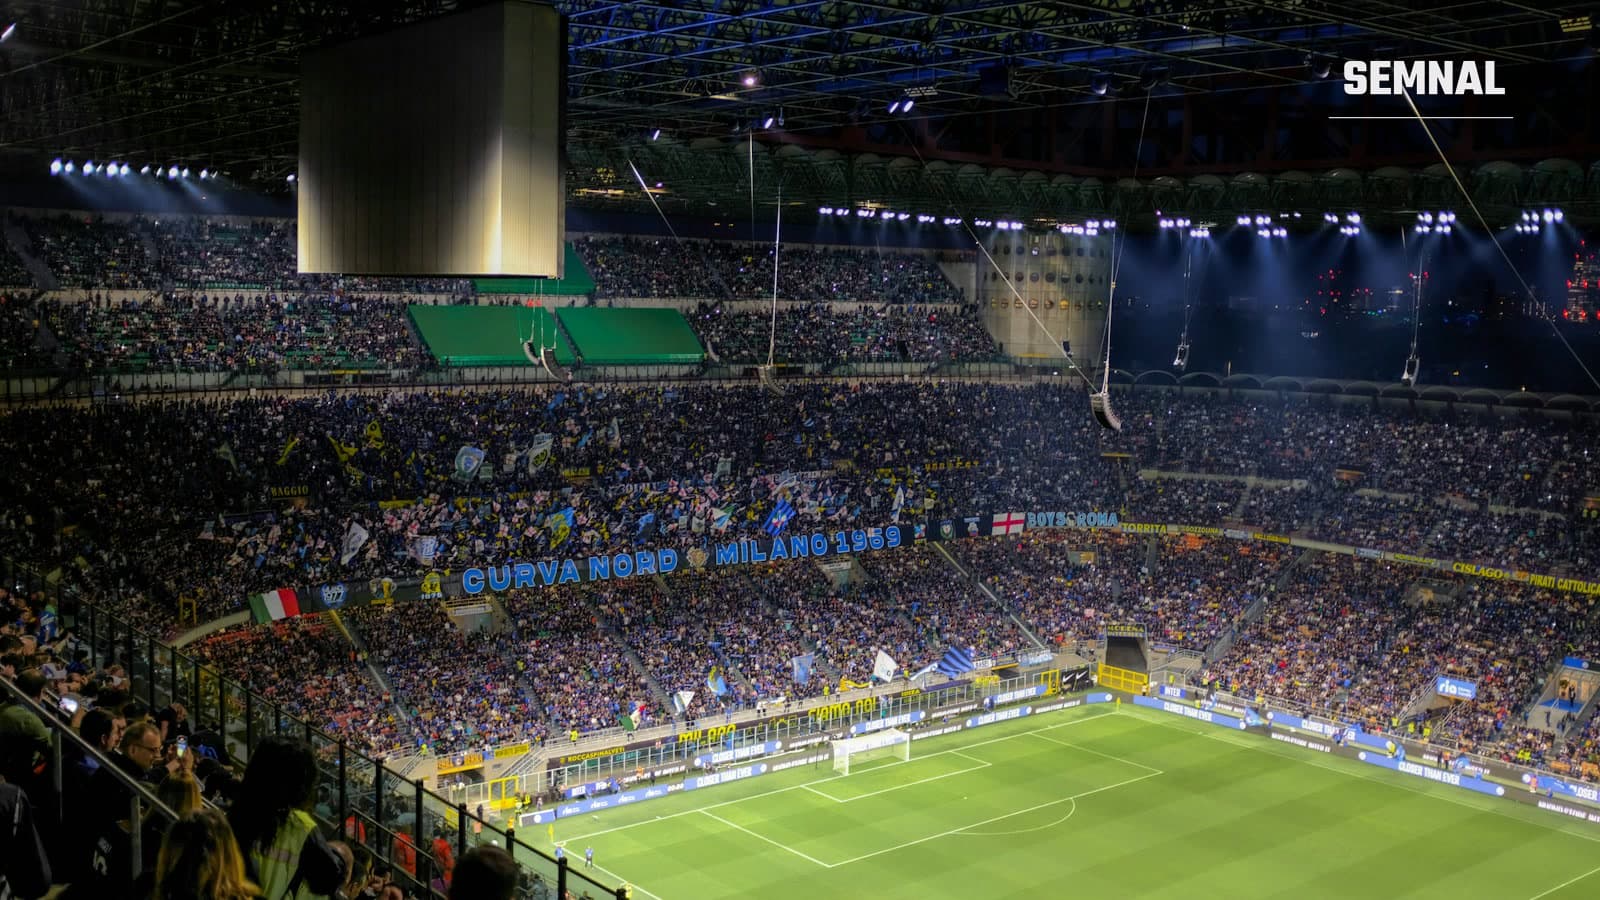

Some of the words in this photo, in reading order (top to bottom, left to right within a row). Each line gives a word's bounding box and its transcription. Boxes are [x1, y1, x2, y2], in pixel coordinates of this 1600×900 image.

[270, 485, 309, 498] BAGGIO
[1027, 512, 1066, 528] BOYS
[1077, 512, 1118, 528] ROMA
[1121, 523, 1168, 534] TORRITA
[715, 533, 828, 566] MILANO
[462, 557, 580, 595] CURVA
[590, 547, 679, 581] NORD
[1453, 561, 1503, 580] CISLAGO
[1529, 573, 1555, 588] PIRATI
[1438, 680, 1457, 694] ria
